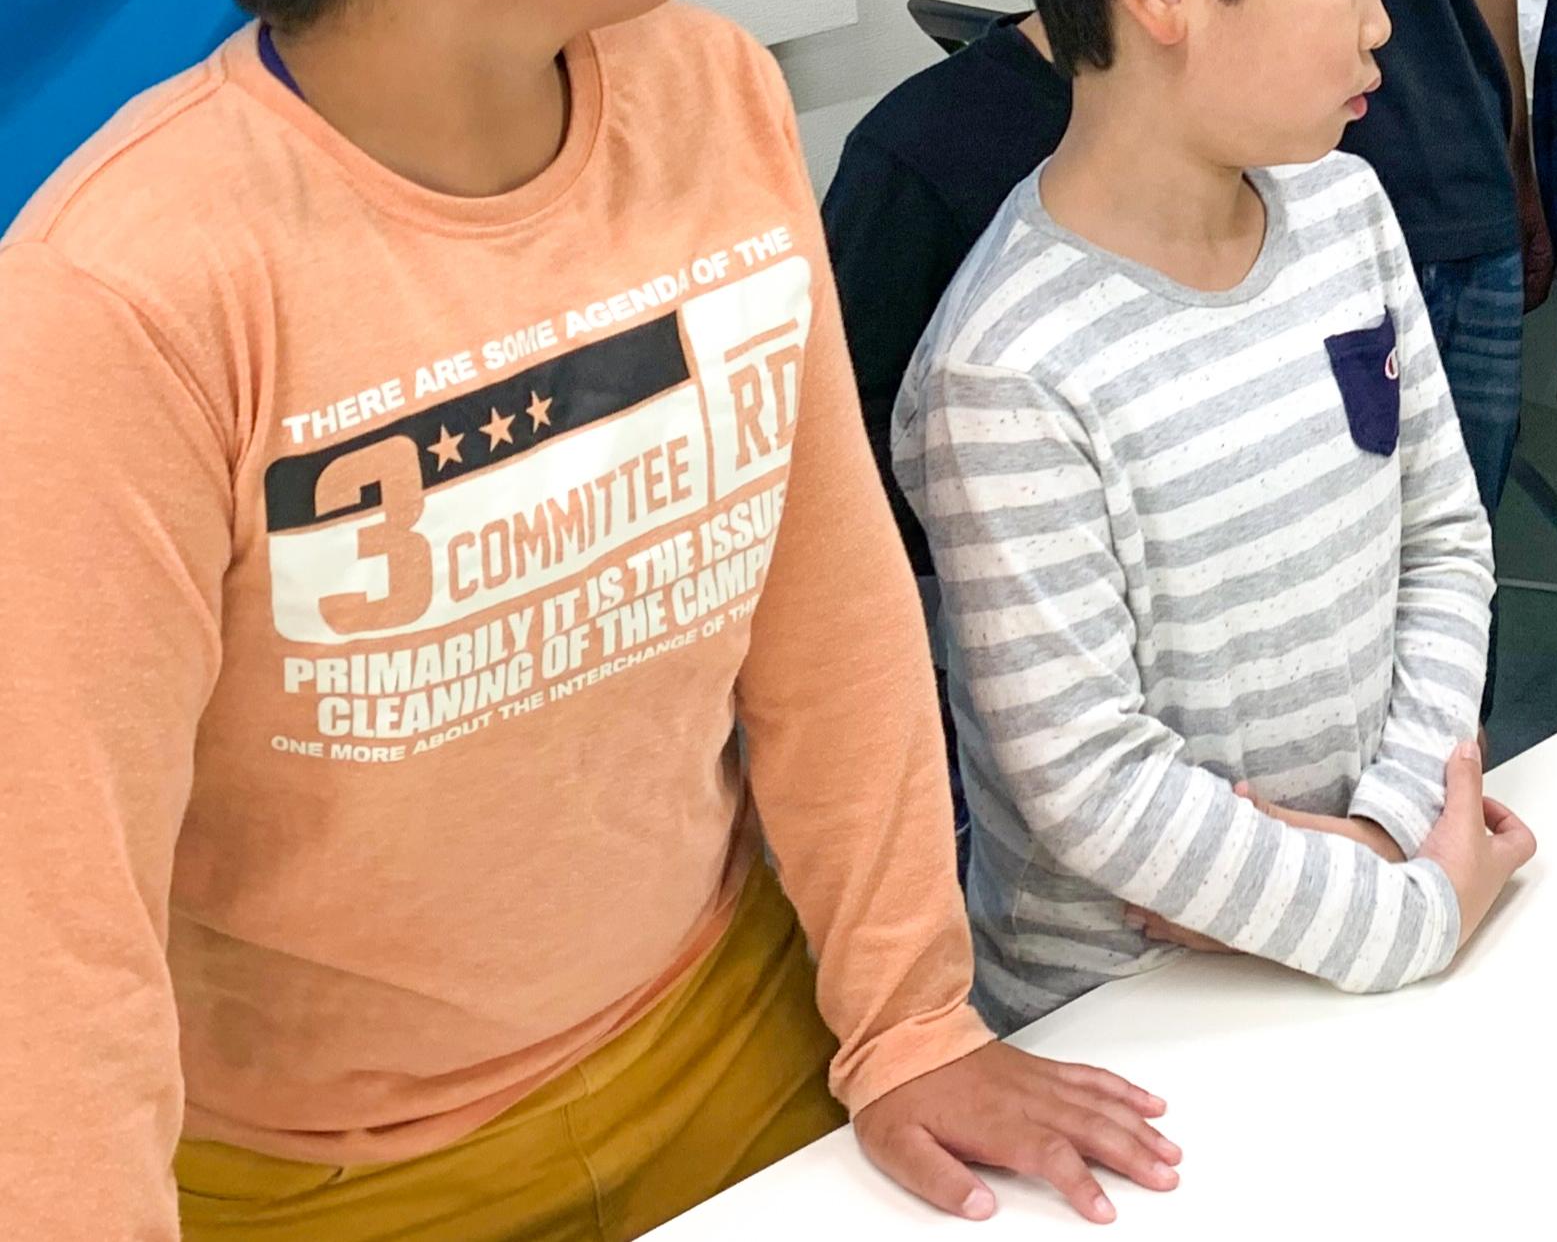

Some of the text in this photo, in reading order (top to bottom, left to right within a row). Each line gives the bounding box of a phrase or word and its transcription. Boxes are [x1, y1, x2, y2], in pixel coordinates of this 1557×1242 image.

[282, 226, 793, 444] THERE ARE SOME AGENDA OF THE
[314, 434, 432, 635] 3
[448, 435, 693, 603] COMMITTEE
[271, 735, 324, 757] ONE
[330, 744, 406, 762] MORE
[412, 711, 494, 755] ABOUT
[498, 691, 545, 721] THE
[549, 630, 698, 702] INTERCHANGE
[702, 616, 725, 639] OF
[284, 606, 534, 696] PRIMARILY
[542, 588, 581, 642] IT
[586, 566, 625, 620] IS
[626, 531, 695, 597] THE
[317, 652, 534, 739] CLEANING
[542, 624, 590, 679] OF
[596, 591, 668, 658] THE
